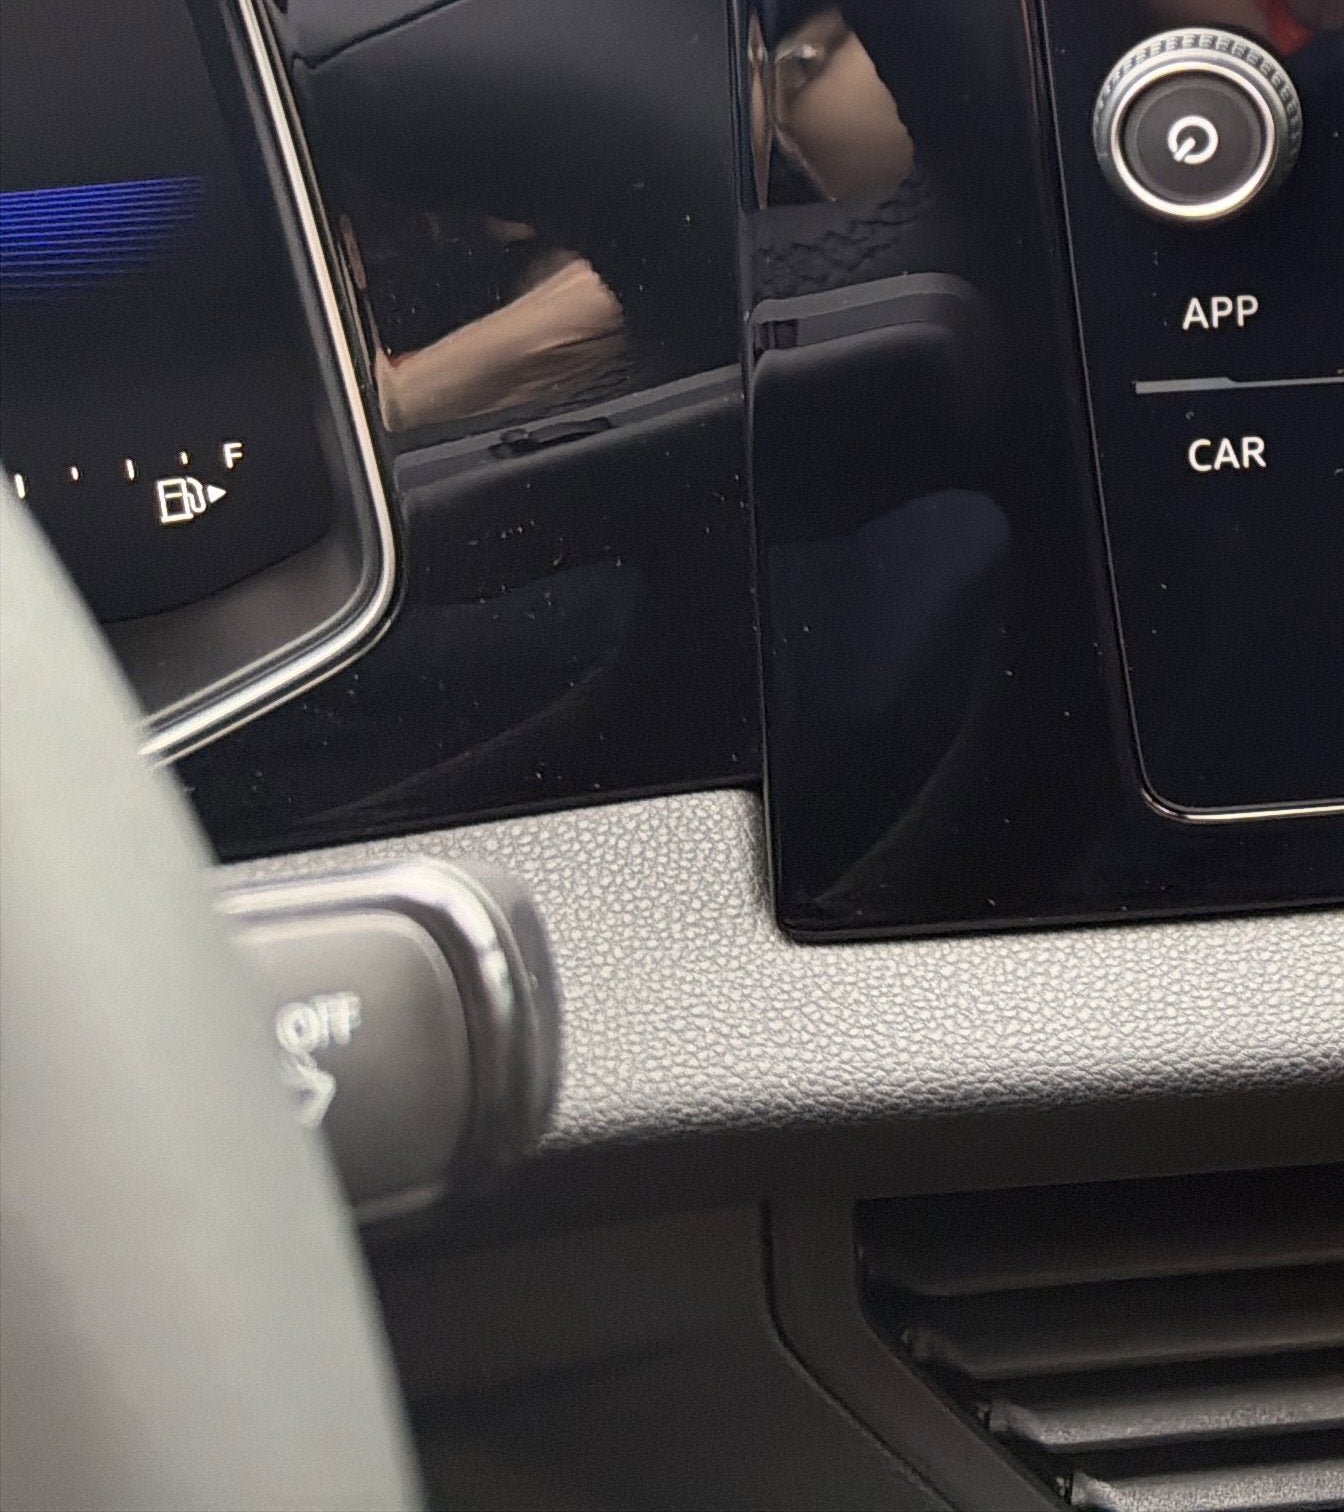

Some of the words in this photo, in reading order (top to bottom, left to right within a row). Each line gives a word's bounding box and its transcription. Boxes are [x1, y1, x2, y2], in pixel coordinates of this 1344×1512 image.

[1182, 295, 1259, 330] APP
[223, 442, 243, 469] F
[1188, 436, 1267, 473] CAR
[275, 992, 361, 1054] OFF
